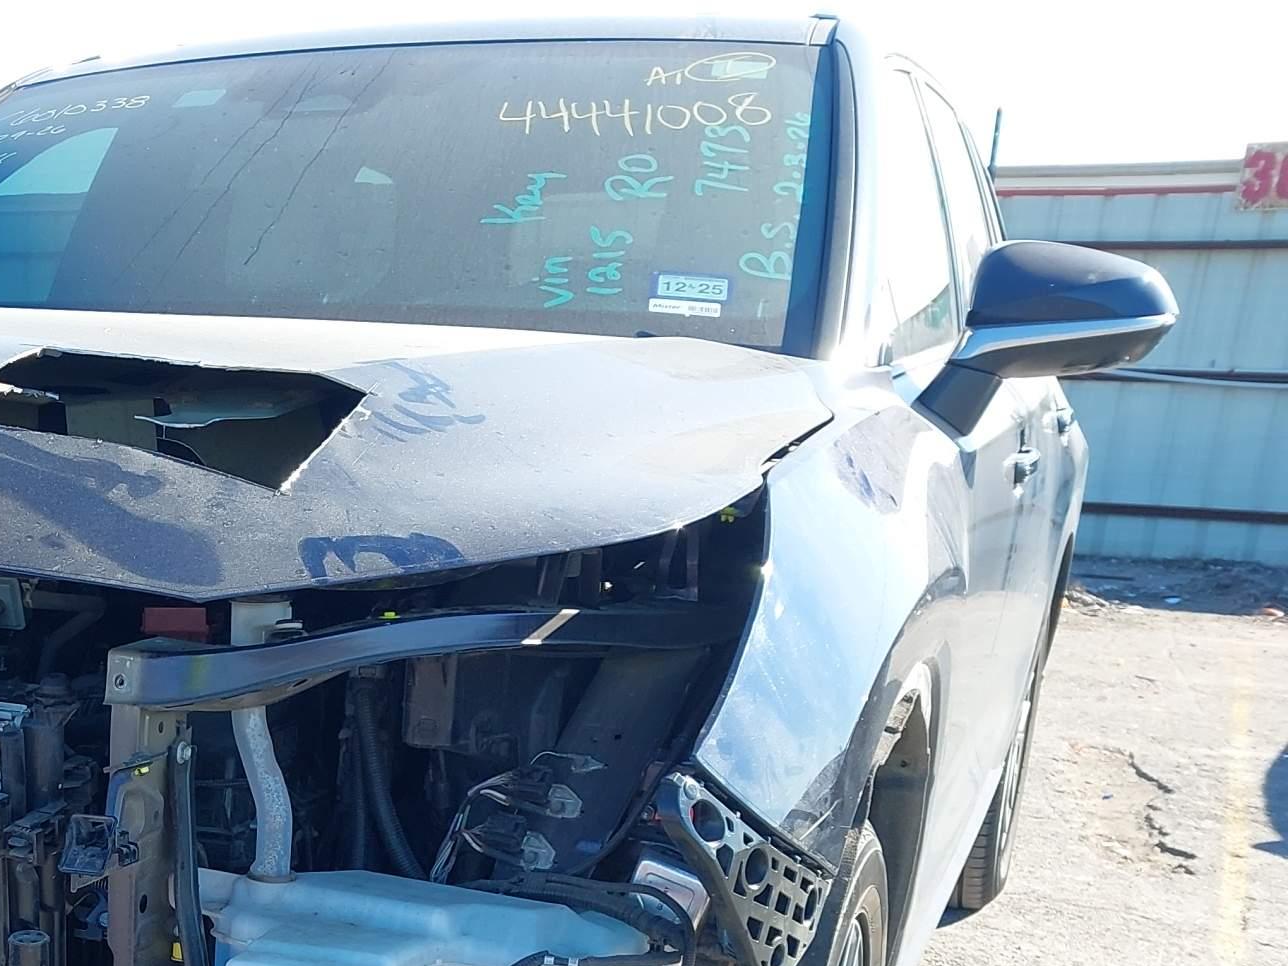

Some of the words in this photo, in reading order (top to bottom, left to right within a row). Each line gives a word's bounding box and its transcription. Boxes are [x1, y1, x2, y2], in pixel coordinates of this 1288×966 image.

[499, 92, 772, 136] 44441008
[585, 225, 633, 295] 1215
[663, 281, 687, 293] 12
[697, 283, 724, 296] 25
